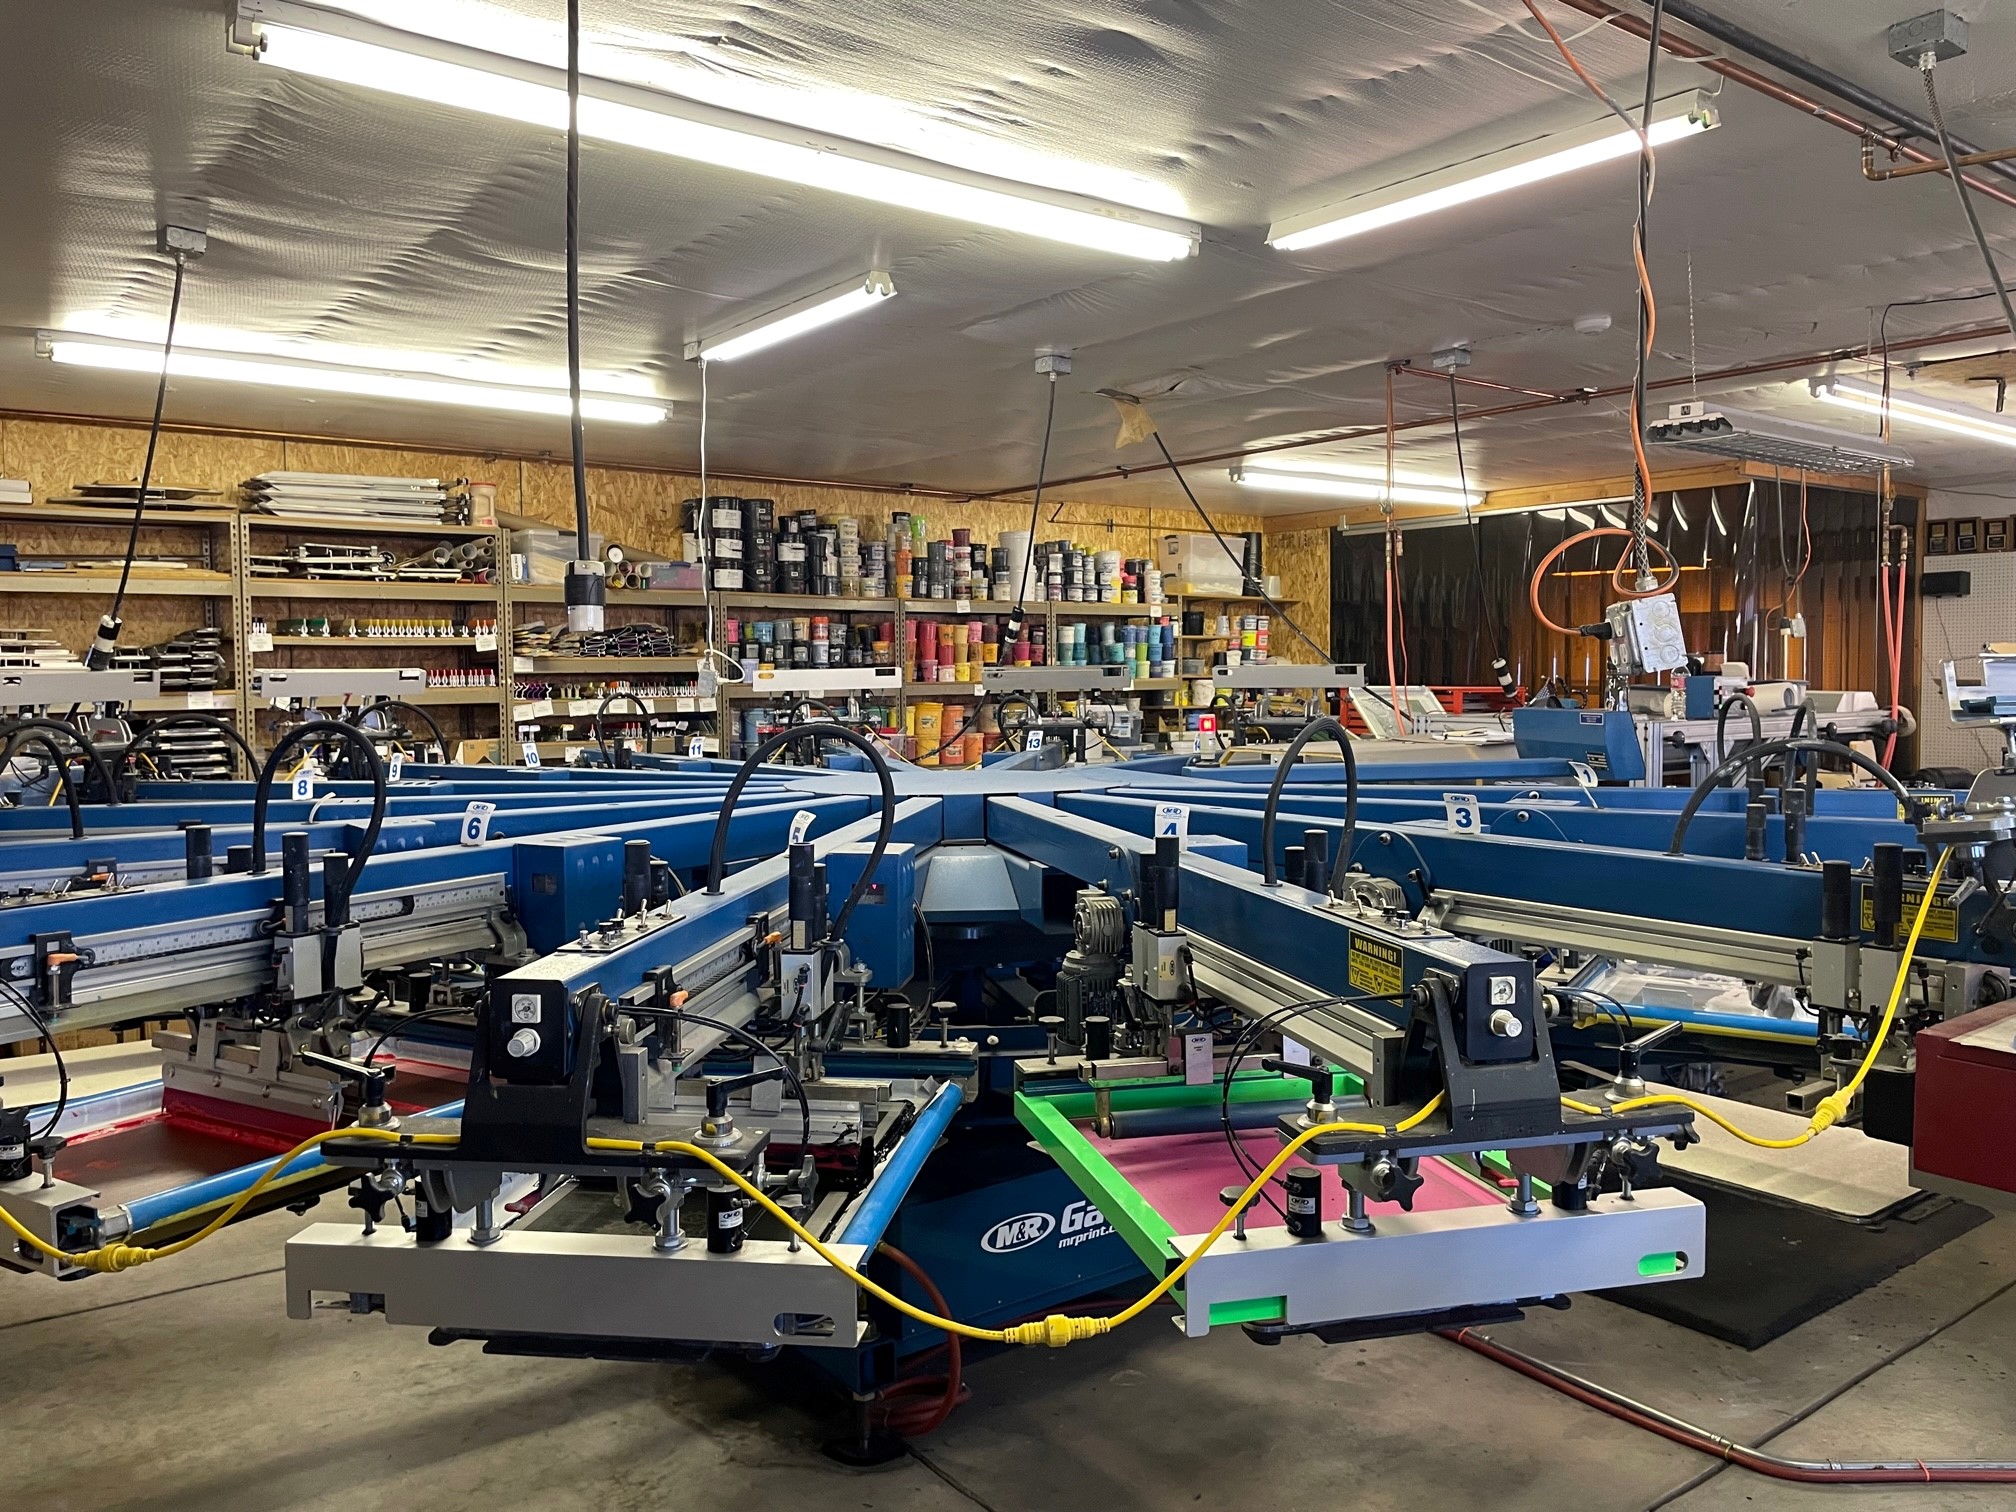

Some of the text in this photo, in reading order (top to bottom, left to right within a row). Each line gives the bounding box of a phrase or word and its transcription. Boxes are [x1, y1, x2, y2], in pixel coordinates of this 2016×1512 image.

[690, 744, 702, 755] 11
[1028, 738, 1040, 748] 13
[525, 752, 538, 765] 10
[391, 764, 398, 777] 9
[1583, 769, 1591, 783] 1
[298, 779, 308, 796] 8
[1455, 807, 1472, 828] 3
[467, 817, 481, 839] 6
[792, 827, 801, 843] 5
[1354, 937, 1397, 963] WARNING!
[995, 1216, 1042, 1249] M&R
